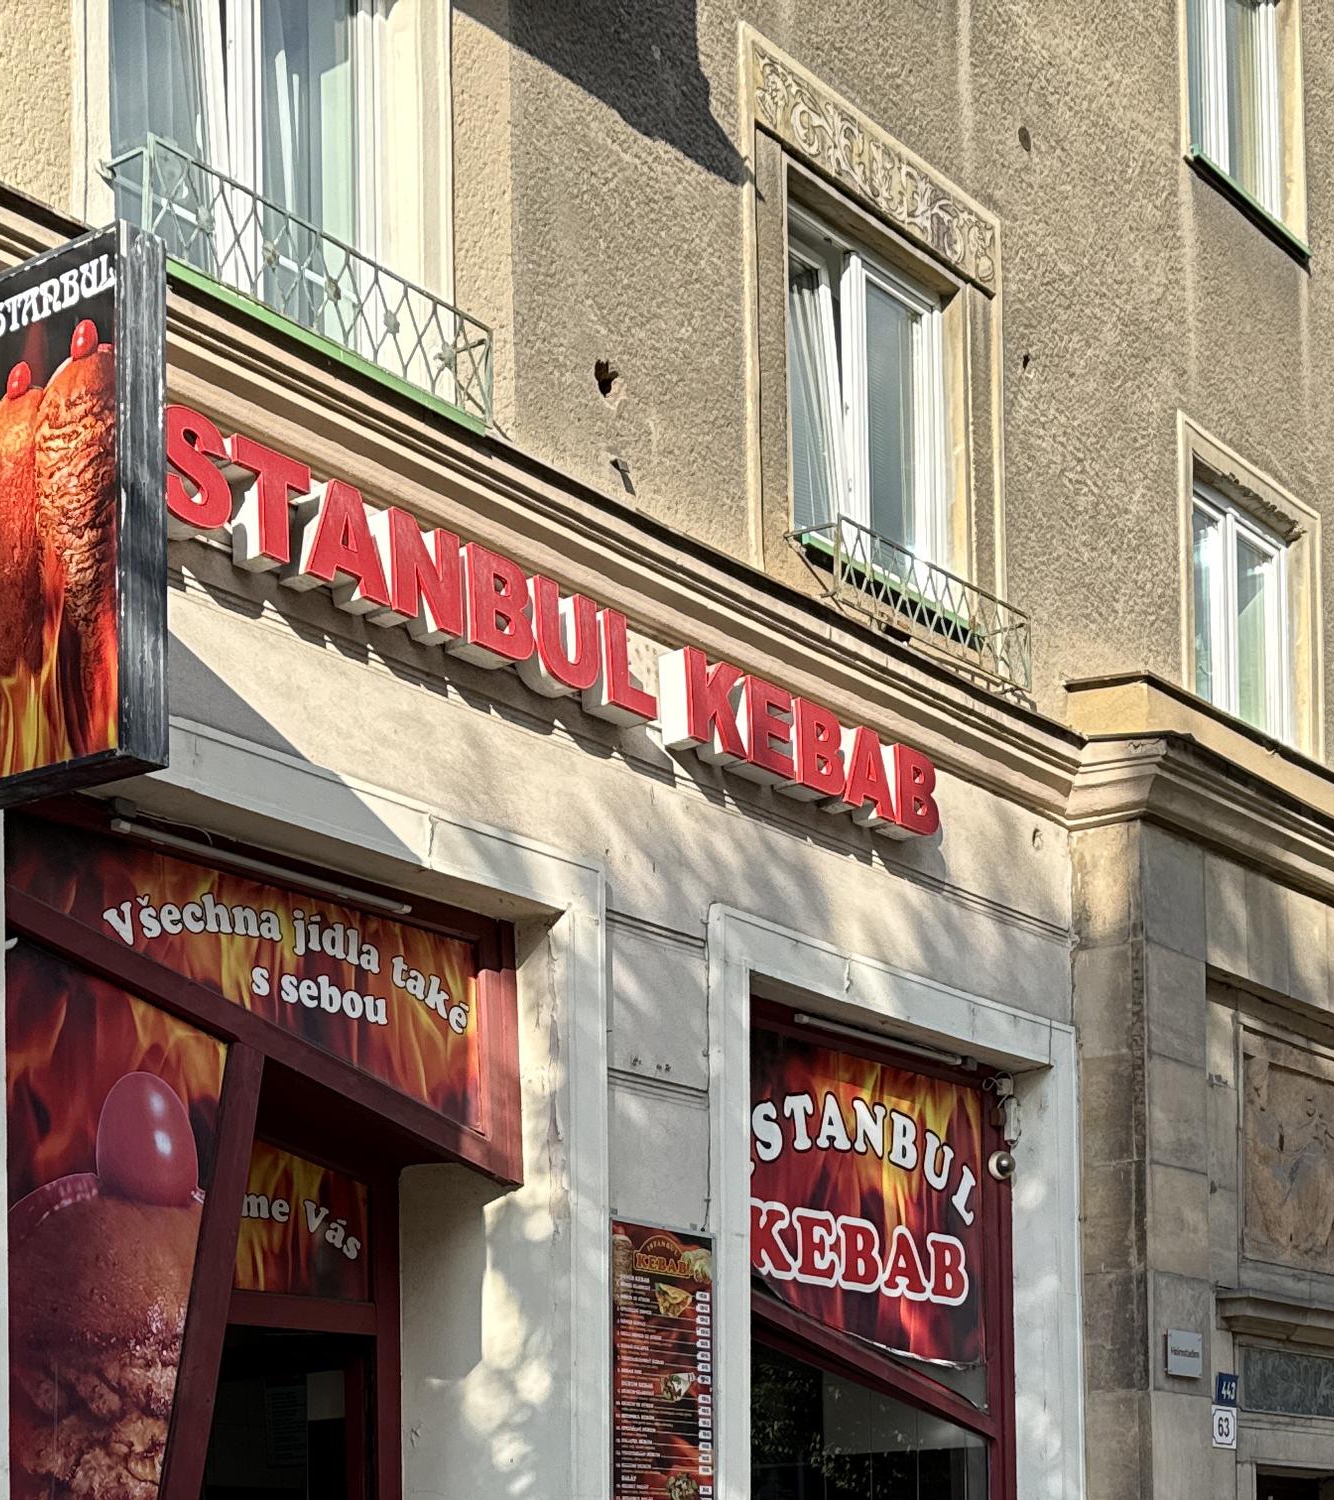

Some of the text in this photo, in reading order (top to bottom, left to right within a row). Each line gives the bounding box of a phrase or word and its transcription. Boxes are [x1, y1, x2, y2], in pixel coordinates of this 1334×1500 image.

[683, 645, 940, 837] KEBAB
[102, 893, 470, 1034] Všechna jídla také
[250, 965, 389, 1026] s sebou
[751, 1091, 976, 1226] STANBUL
[303, 1199, 362, 1260] Vás
[751, 1198, 970, 1306] KEBAB
[635, 1255, 689, 1274] KEBAB
[1222, 1381, 1235, 1400] 443
[1218, 1417, 1230, 1437] 63
